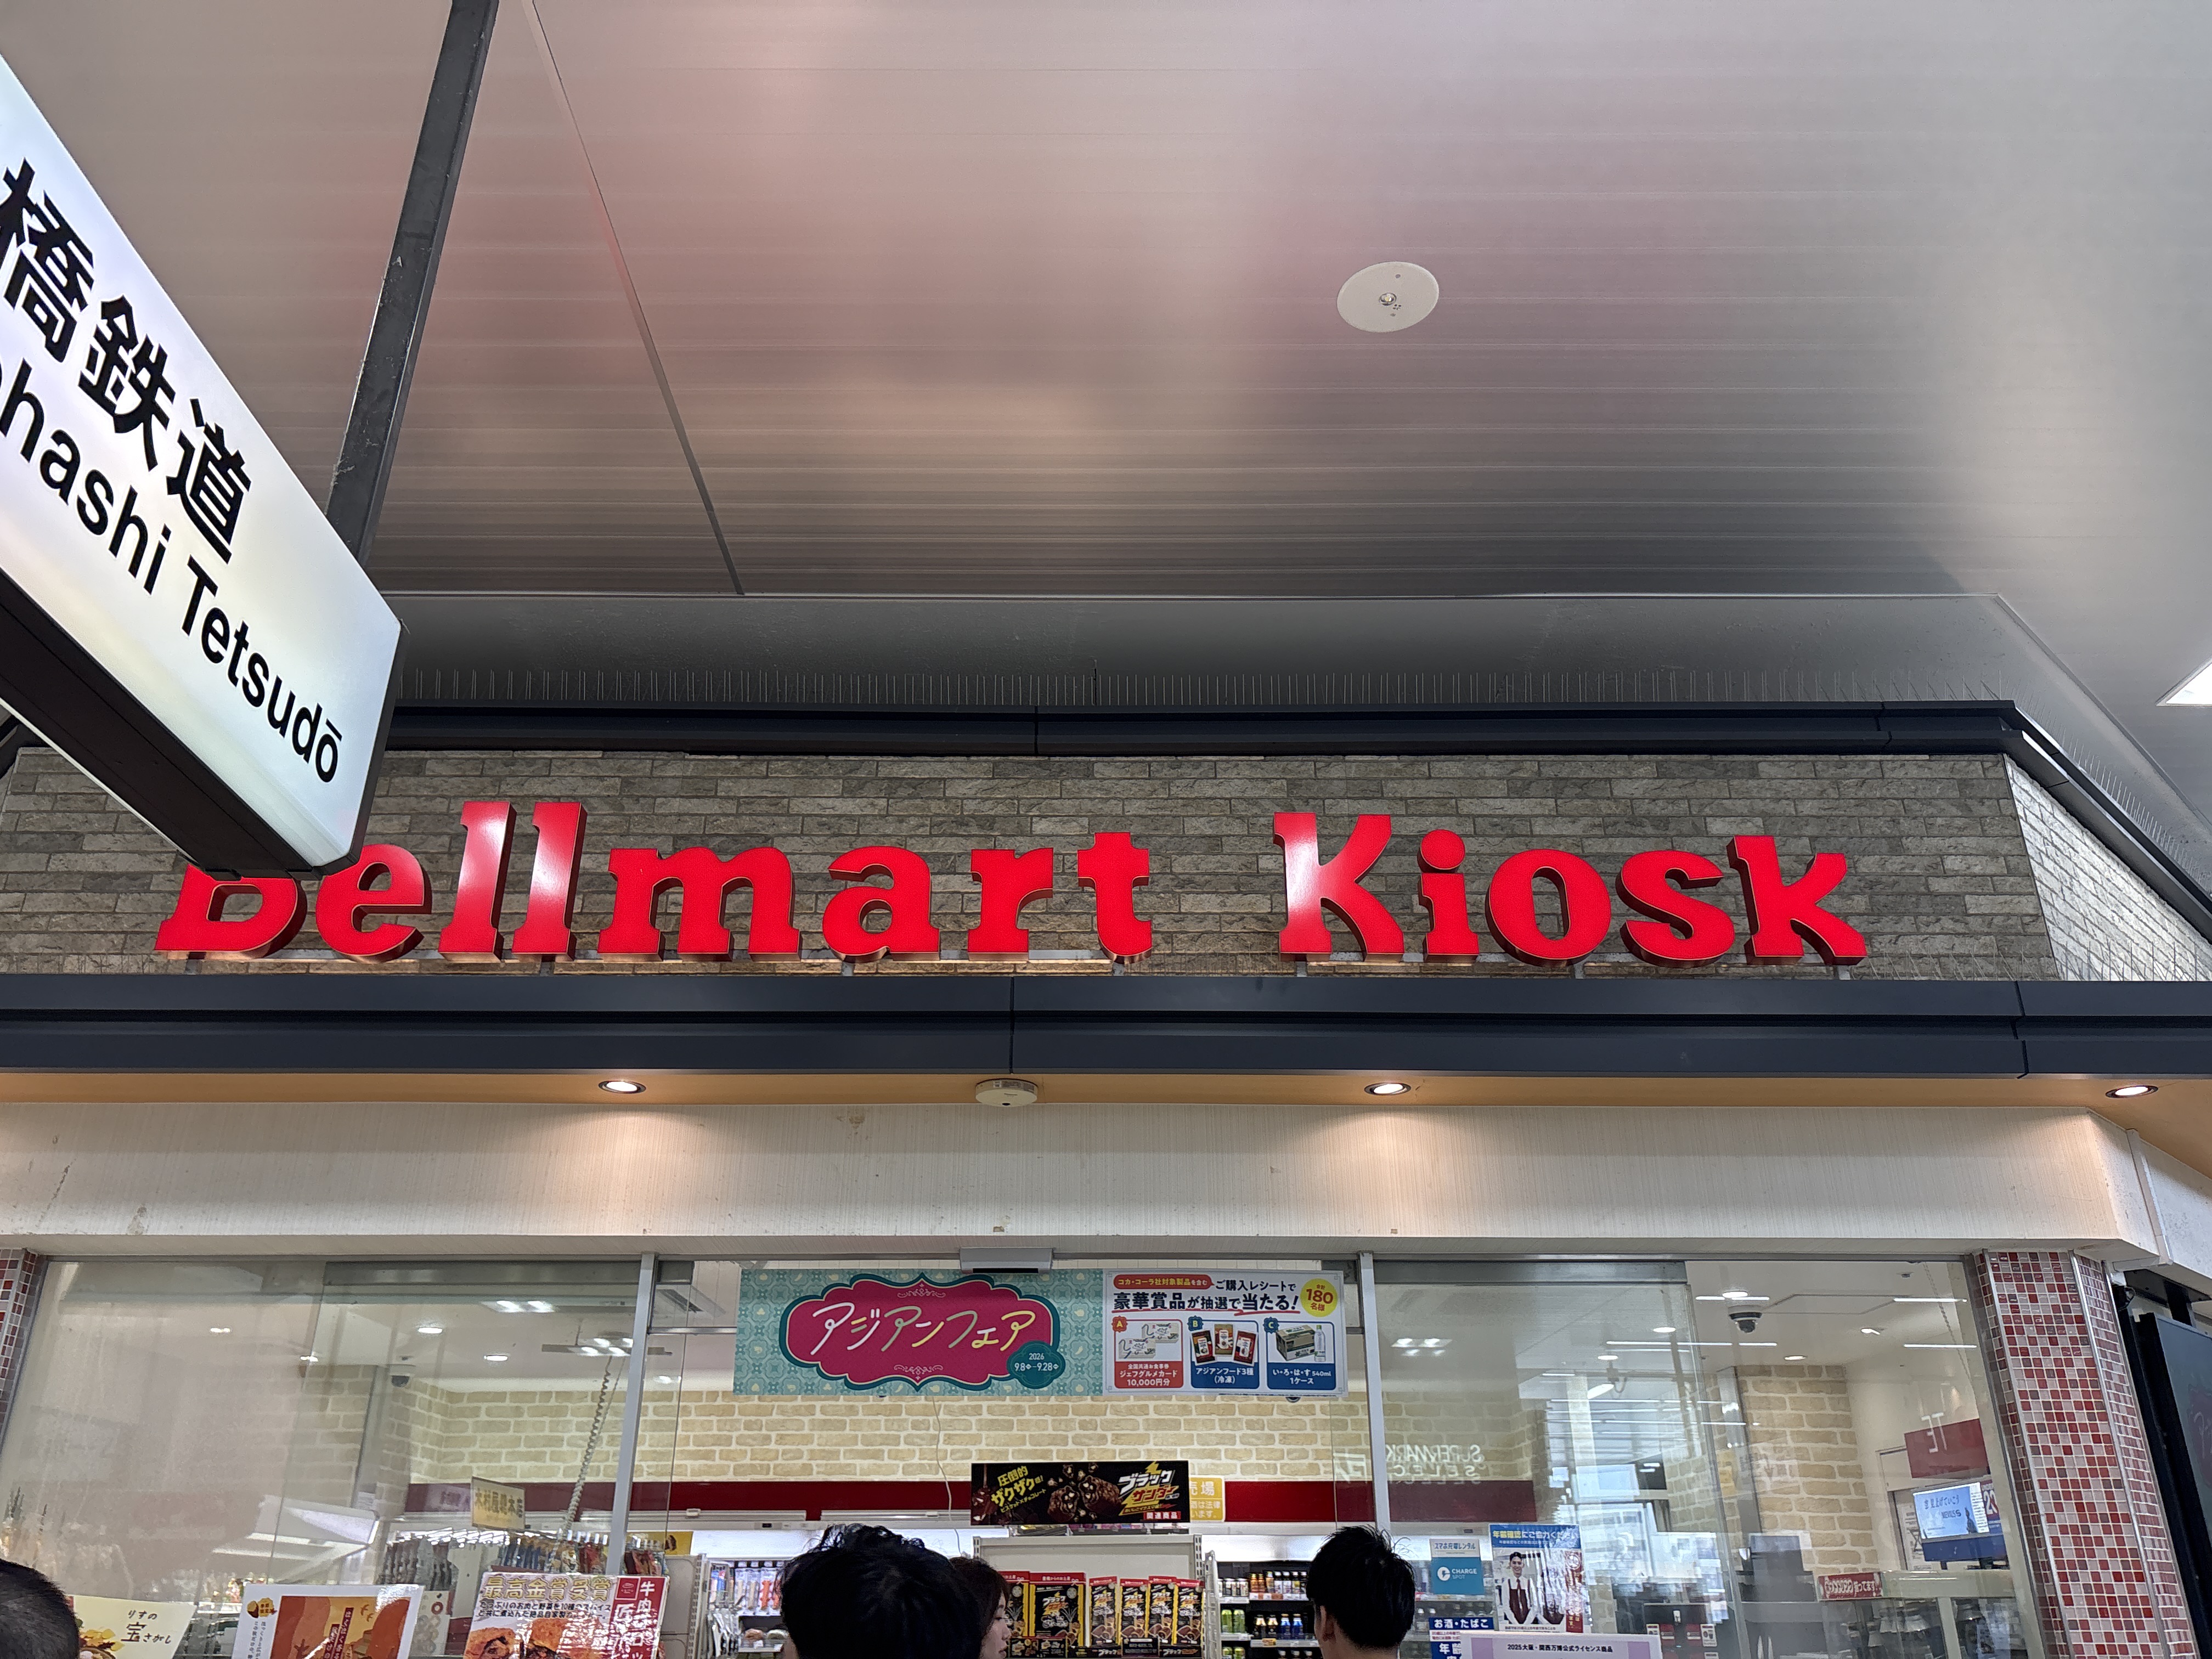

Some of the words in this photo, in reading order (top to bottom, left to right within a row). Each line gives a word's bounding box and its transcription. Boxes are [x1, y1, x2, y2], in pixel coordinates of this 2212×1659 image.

[0, 358, 170, 595] hashi
[154, 801, 1153, 963] Bellmart
[1273, 811, 1867, 967] Kiosk
[1215, 1279, 1296, 1292] ご購入レシートで
[1306, 1288, 1333, 1304] 180
[810, 1302, 1036, 1356] アジアンフェア
[1127, 1378, 1170, 1387] 10,000円分
[1289, 1376, 1314, 1385] 1ケース
[1119, 1470, 1173, 1495] ブラック
[483, 1575, 612, 1601] 最高金賞受賞
[127, 1610, 157, 1620] りすの
[1434, 1618, 1489, 1629] お酒・たばこ
[121, 1622, 172, 1645] 宝さがし
